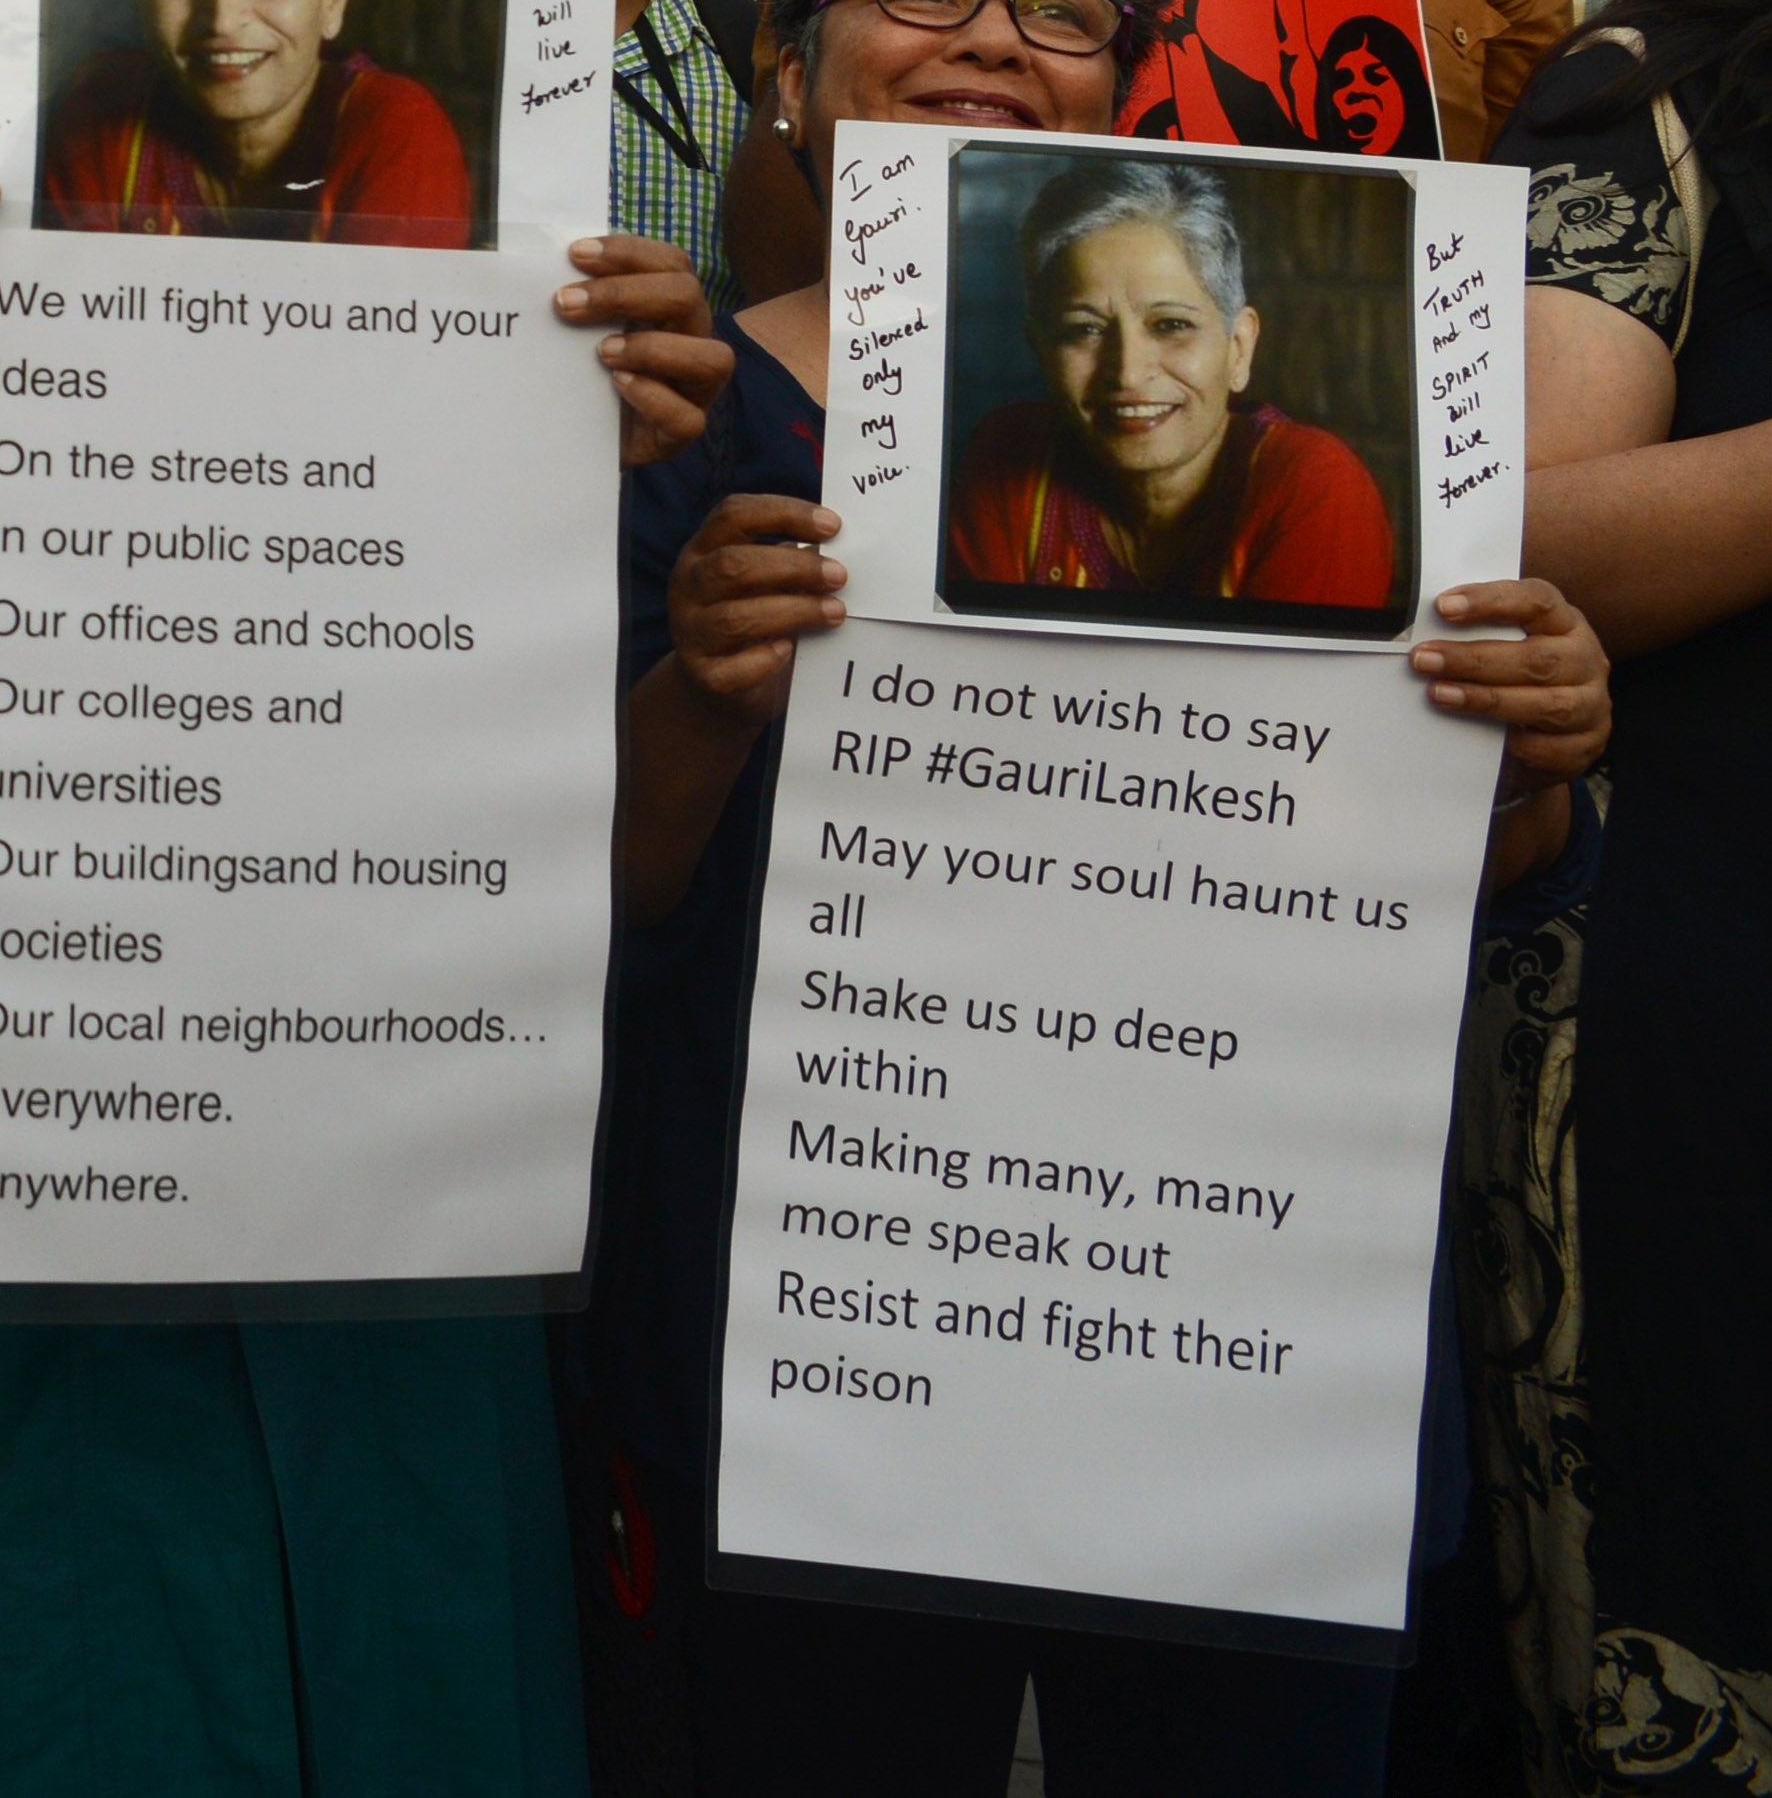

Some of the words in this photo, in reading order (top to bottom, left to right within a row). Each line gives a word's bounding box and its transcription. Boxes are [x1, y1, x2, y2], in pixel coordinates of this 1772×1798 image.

[539, 38, 576, 60] live
[840, 160, 872, 202] I
[882, 155, 915, 180] am
[1427, 233, 1464, 271] But
[81, 286, 146, 321] will
[161, 287, 249, 334] fight
[262, 301, 332, 337] you
[346, 299, 417, 334] and
[431, 309, 520, 344] your
[1423, 270, 1484, 316] TRUTH
[1469, 304, 1490, 329] my
[862, 358, 901, 395] only
[1432, 351, 1489, 400] SPIRIT
[861, 415, 897, 449] my
[69, 444, 135, 481] the
[151, 450, 289, 486] streets
[303, 454, 375, 489] and
[42, 527, 113, 557] our
[127, 524, 250, 568] public
[264, 535, 404, 574] spaces
[81, 603, 219, 644] offices
[234, 610, 308, 647] and
[323, 612, 474, 651] schools
[78, 683, 253, 731] colleges
[268, 689, 343, 725] and
[843, 660, 855, 698] I
[872, 663, 935, 708] do
[953, 683, 1037, 720] not
[1053, 689, 1162, 735] wish
[1181, 703, 1231, 742] to
[1246, 718, 1331, 764] say
[832, 730, 912, 777] RIP
[926, 733, 1298, 827] #GauriLankesh
[353, 849, 507, 896] housing
[821, 821, 928, 880] May
[943, 845, 1057, 886] your
[1071, 860, 1174, 901] soul
[1191, 866, 1339, 922] haunt
[1355, 897, 1409, 931] us
[809, 892, 865, 939] all
[69, 1003, 164, 1041] local
[800, 970, 947, 1025] Shake
[966, 999, 1017, 1034] us
[1036, 1007, 1097, 1052] up
[1114, 1007, 1238, 1070] deep
[796, 1046, 947, 1100] within
[789, 1119, 971, 1190] Making
[987, 1154, 1135, 1209] many,
[1156, 1176, 1295, 1230] many
[782, 1203, 911, 1246] more
[927, 1221, 1070, 1267] speak
[1087, 1241, 1171, 1279] out
[778, 1270, 919, 1330] Resist
[935, 1296, 1026, 1342] and
[1043, 1300, 1157, 1362] fight
[1172, 1318, 1293, 1375] their
[771, 1355, 932, 1407] poison
